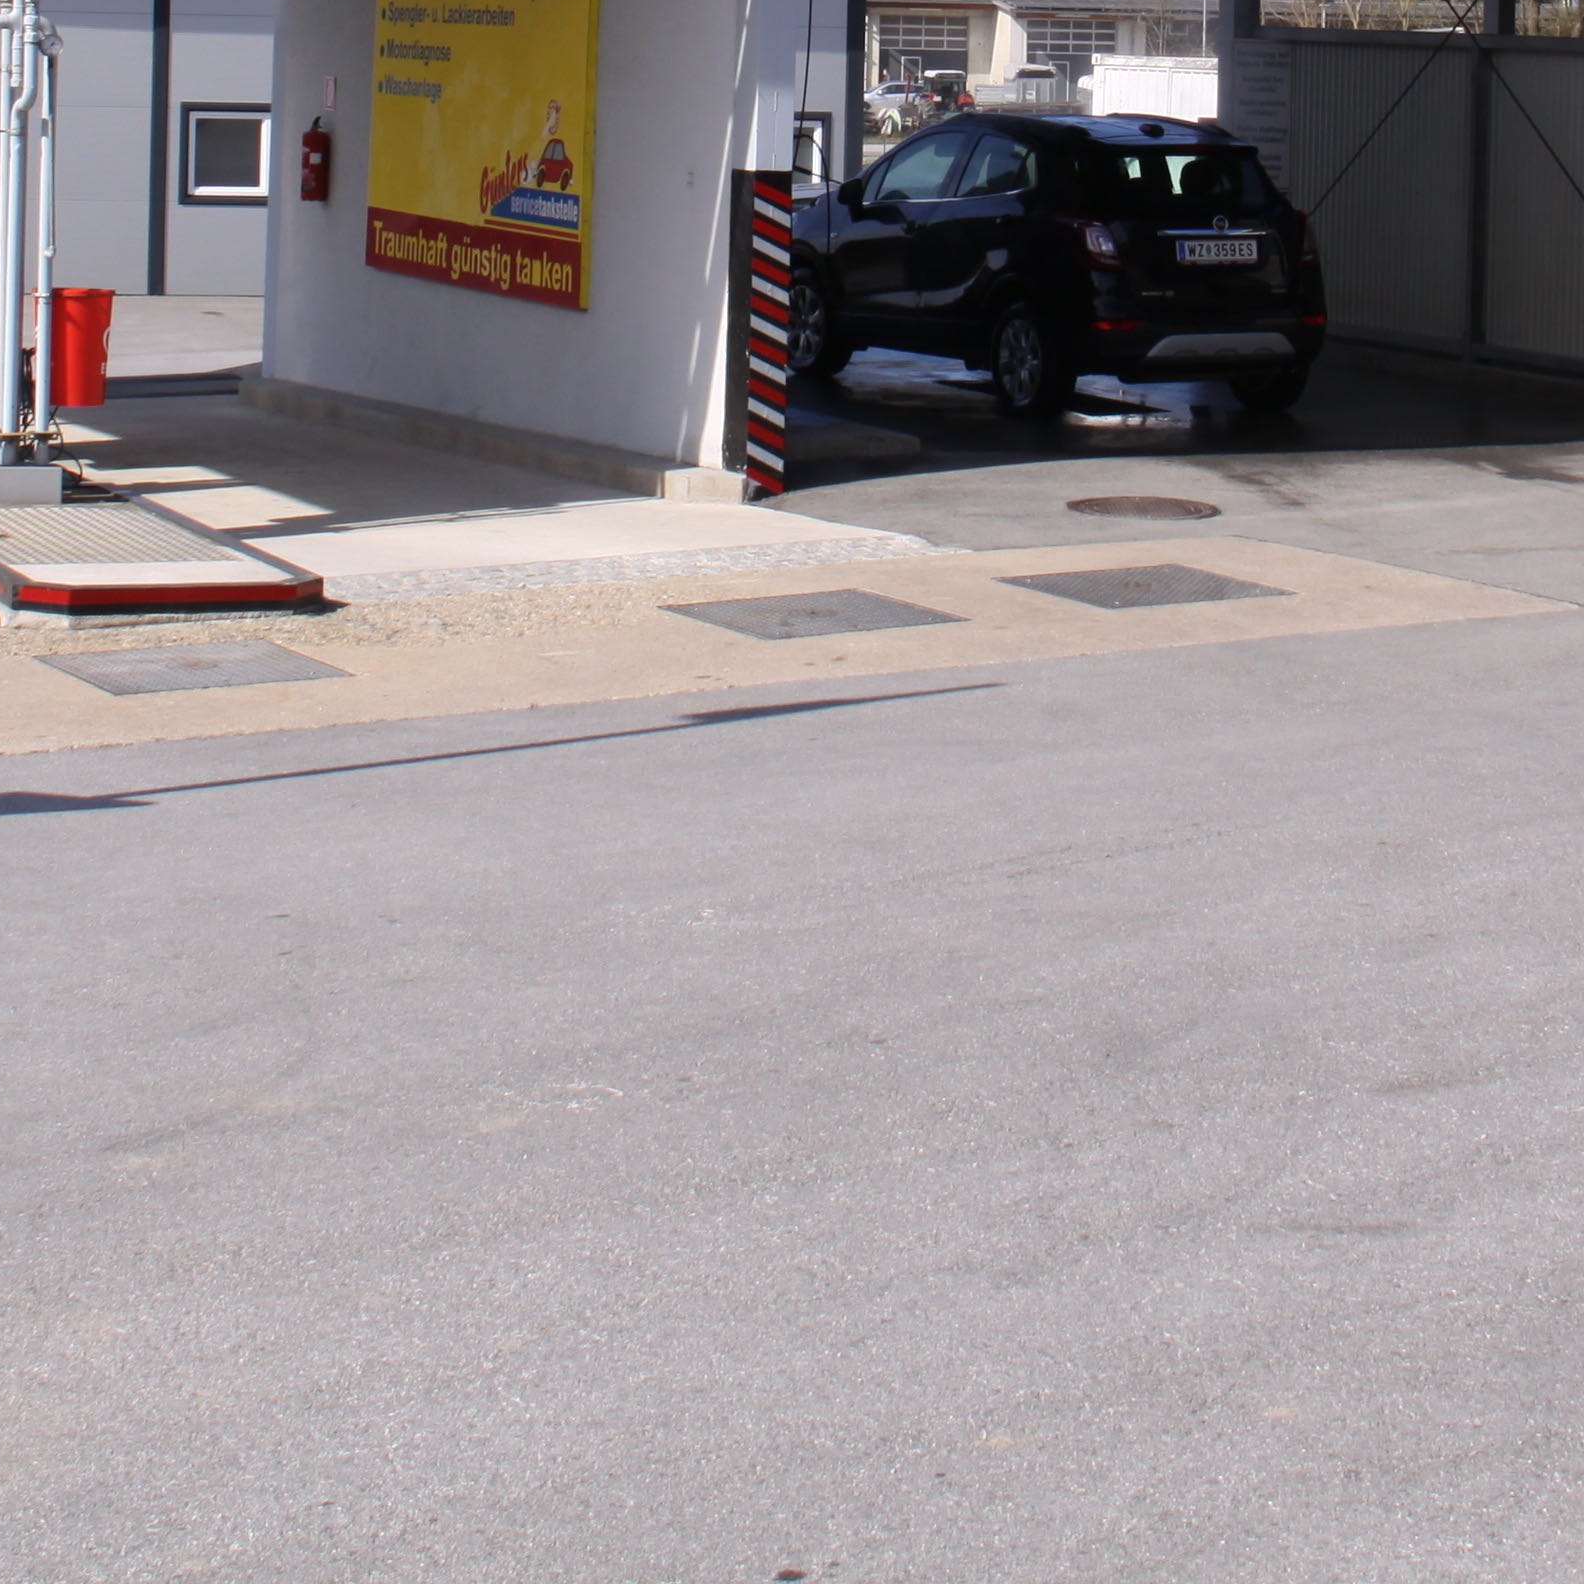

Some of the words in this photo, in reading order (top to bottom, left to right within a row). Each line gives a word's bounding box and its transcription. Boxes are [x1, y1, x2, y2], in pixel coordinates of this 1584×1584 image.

[388, 1, 430, 27] Spengler-
[442, 3, 516, 27] Lackierarbeiten
[386, 38, 452, 66] Motordiagnose
[383, 74, 443, 104] Waschanlage
[510, 193, 580, 224] servicetankstelle
[372, 219, 448, 268] Traumhaft
[450, 236, 512, 291] günstig
[515, 247, 573, 293] taken
[1187, 243, 1205, 258] WZ
[1213, 242, 1254, 258] 359ES
